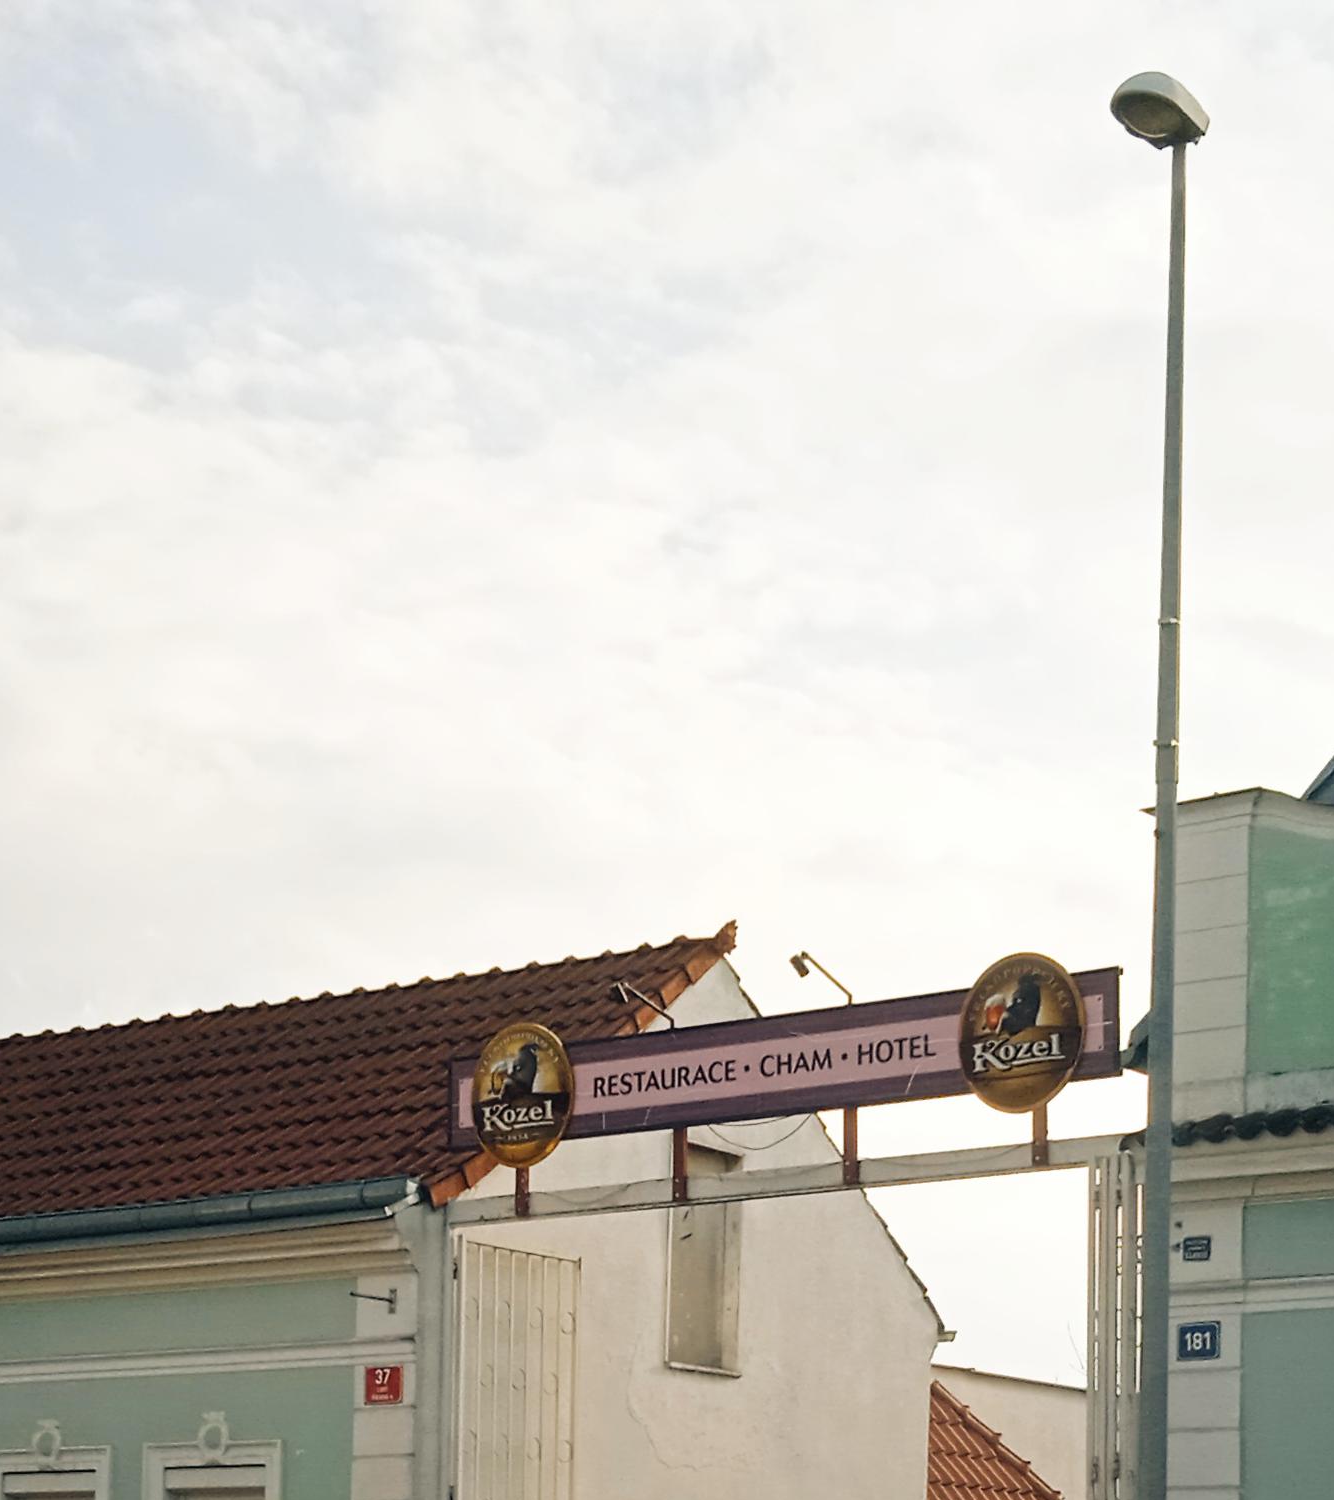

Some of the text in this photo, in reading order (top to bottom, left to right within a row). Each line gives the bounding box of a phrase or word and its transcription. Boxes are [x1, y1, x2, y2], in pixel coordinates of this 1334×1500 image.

[592, 1033, 937, 1098] RESTAURACE CHAM HOTEL
[972, 1033, 1066, 1073] Kozel
[481, 1100, 555, 1131] Kozel
[1184, 1331, 1212, 1351] 181
[374, 1368, 391, 1385] 37
